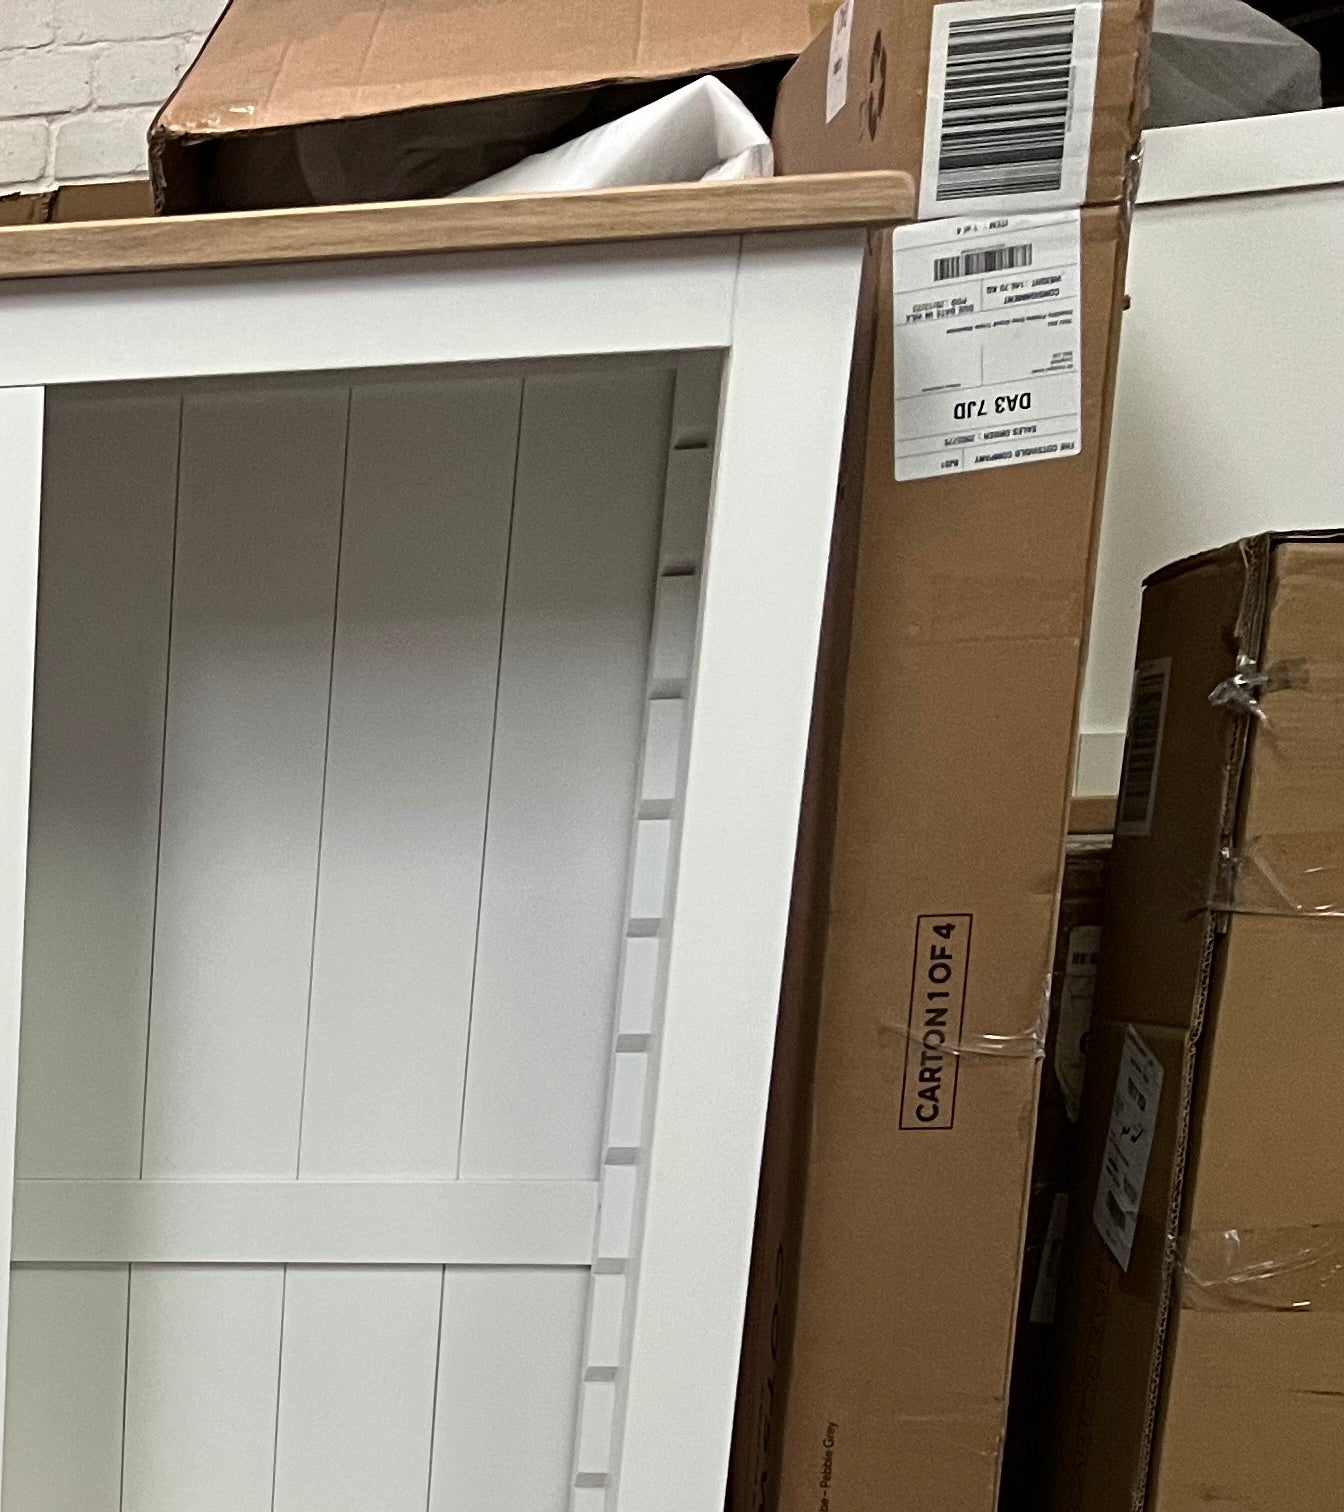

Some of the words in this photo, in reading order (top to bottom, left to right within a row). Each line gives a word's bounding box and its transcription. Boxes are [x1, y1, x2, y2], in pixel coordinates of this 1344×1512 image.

[951, 398, 987, 421] 7JD
[992, 391, 1033, 414] DA3
[931, 921, 956, 940] 4
[926, 943, 954, 984] OF
[926, 990, 949, 1002] 1
[914, 1005, 948, 1123] CARTON
[822, 1420, 838, 1449] Grey
[819, 1448, 834, 1488] Pebble
